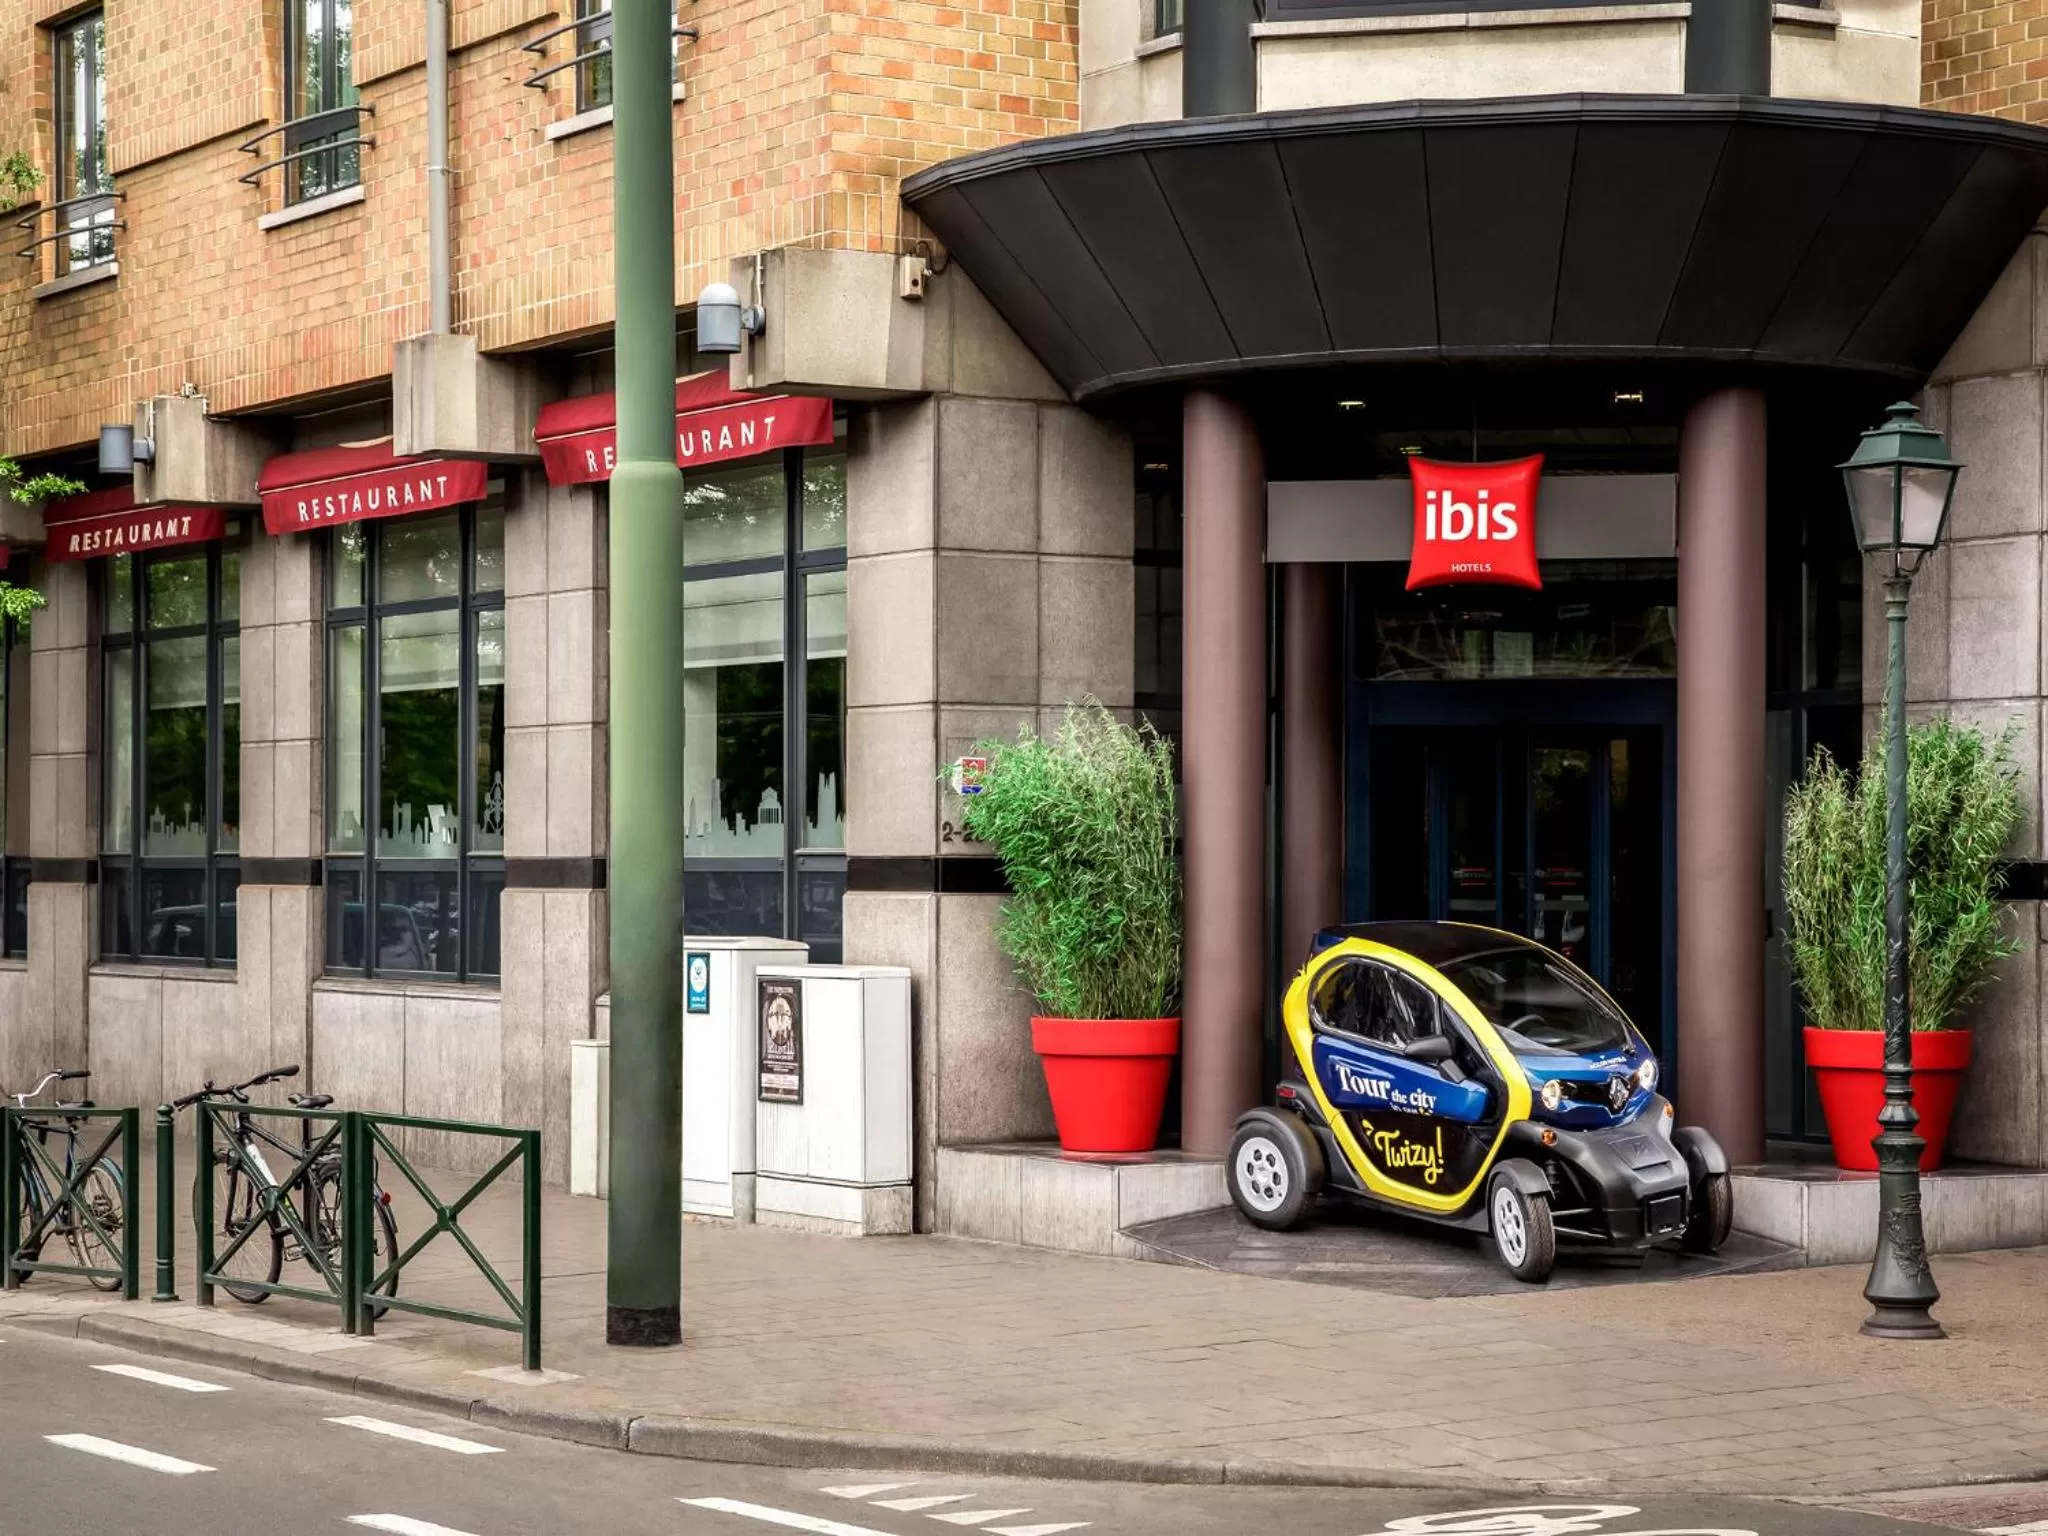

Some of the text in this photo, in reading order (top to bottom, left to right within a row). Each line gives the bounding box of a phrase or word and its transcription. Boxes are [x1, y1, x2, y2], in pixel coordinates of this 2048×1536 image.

[585, 416, 775, 473] REURANT
[298, 476, 447, 522] RESTAURANT
[1425, 488, 1518, 541] ibis
[69, 516, 192, 552] RESTAURANT
[1451, 563, 1491, 573] HOTELS
[1336, 1064, 1390, 1100] Tour
[1391, 1089, 1408, 1104] the
[1409, 1088, 1437, 1109] city
[1374, 1126, 1444, 1184] Twizy!
